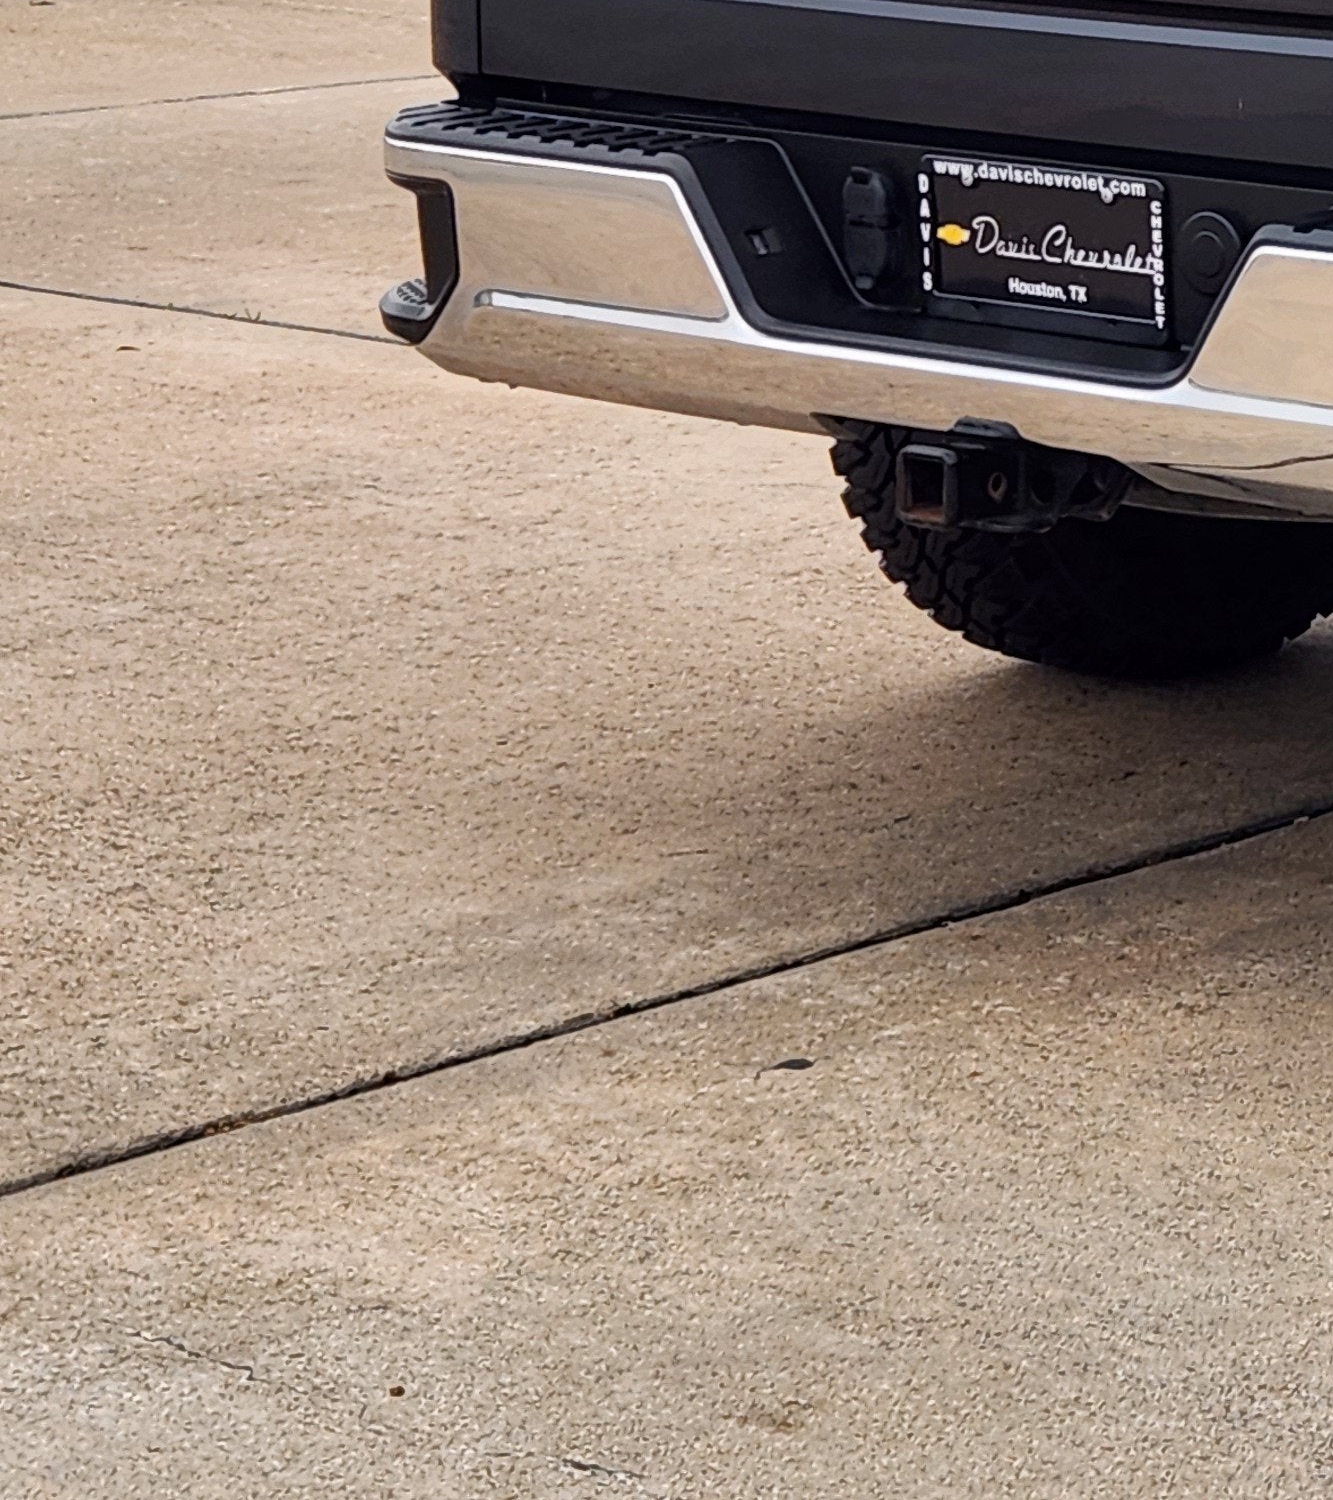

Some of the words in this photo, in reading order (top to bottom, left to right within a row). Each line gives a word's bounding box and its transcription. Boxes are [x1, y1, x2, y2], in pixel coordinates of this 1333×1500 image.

[917, 173, 933, 291] DAVIS
[972, 216, 1042, 260] Davis
[1150, 200, 1166, 329] CHEVROLET
[1008, 277, 1066, 301] Houston,
[1068, 283, 1087, 303] TX
